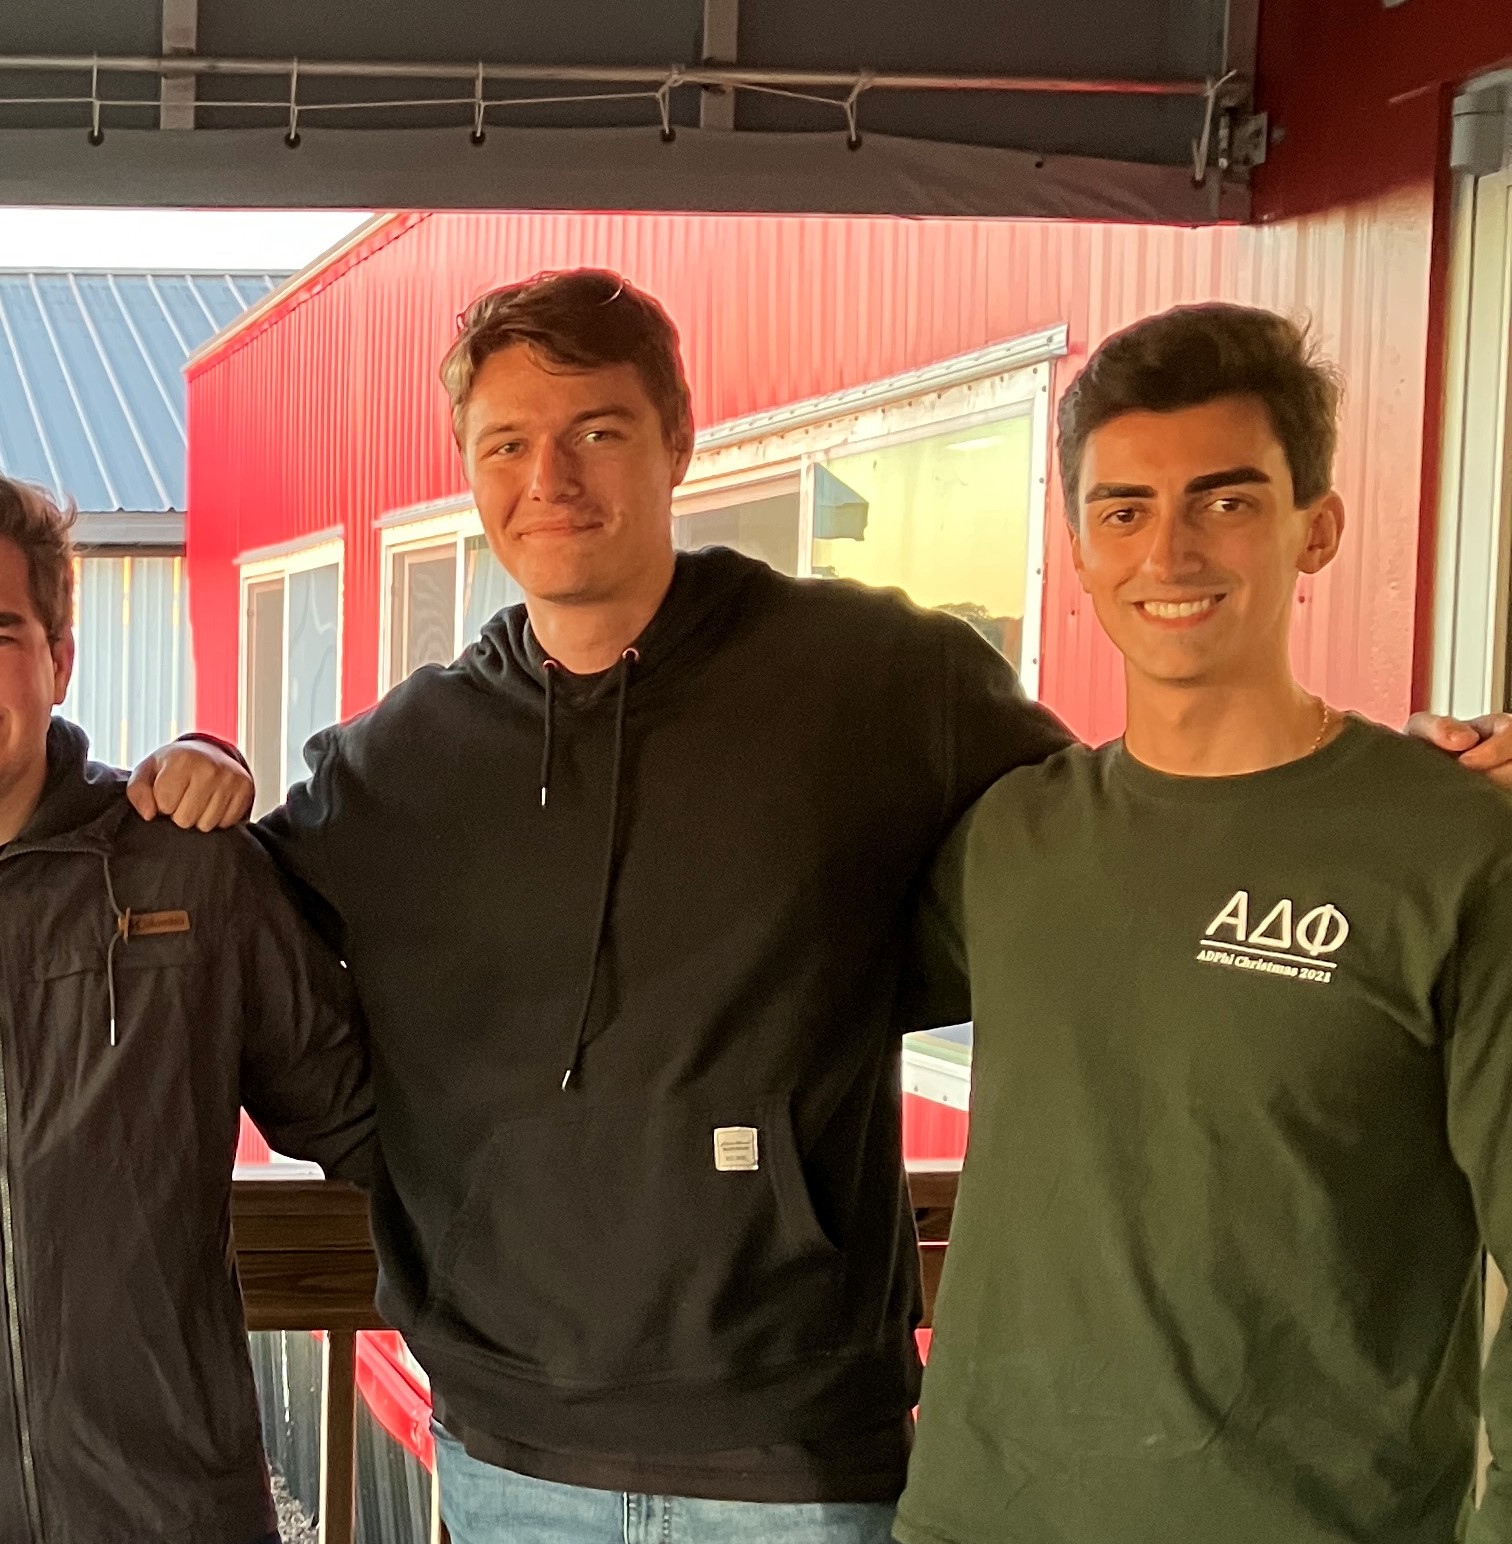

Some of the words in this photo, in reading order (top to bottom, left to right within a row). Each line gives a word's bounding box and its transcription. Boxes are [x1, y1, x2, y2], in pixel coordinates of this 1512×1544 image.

[1197, 949, 1235, 965] ADPhi
[1235, 955, 1299, 977] Christmas
[1299, 967, 1331, 983] 2021
